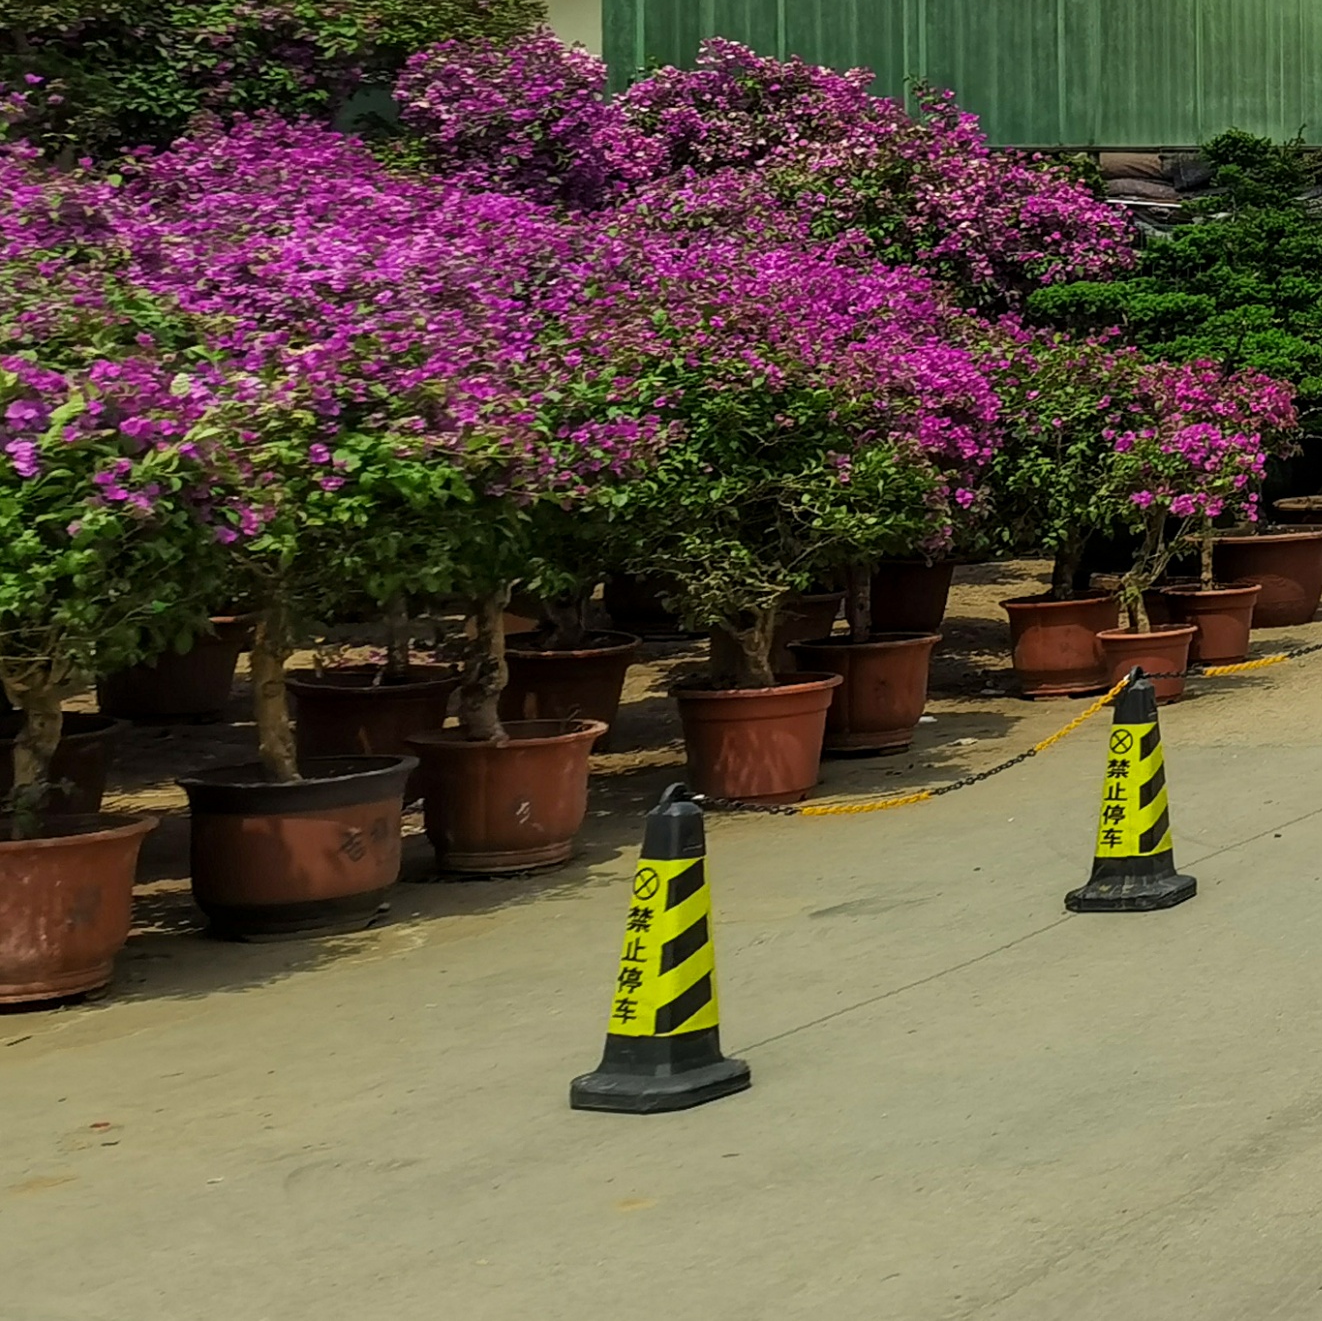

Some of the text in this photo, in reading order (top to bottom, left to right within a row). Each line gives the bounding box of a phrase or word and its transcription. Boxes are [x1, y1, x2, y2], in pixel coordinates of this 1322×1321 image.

[1100, 758, 1131, 848] 禁止停车
[612, 905, 654, 1025] 禁止停车
